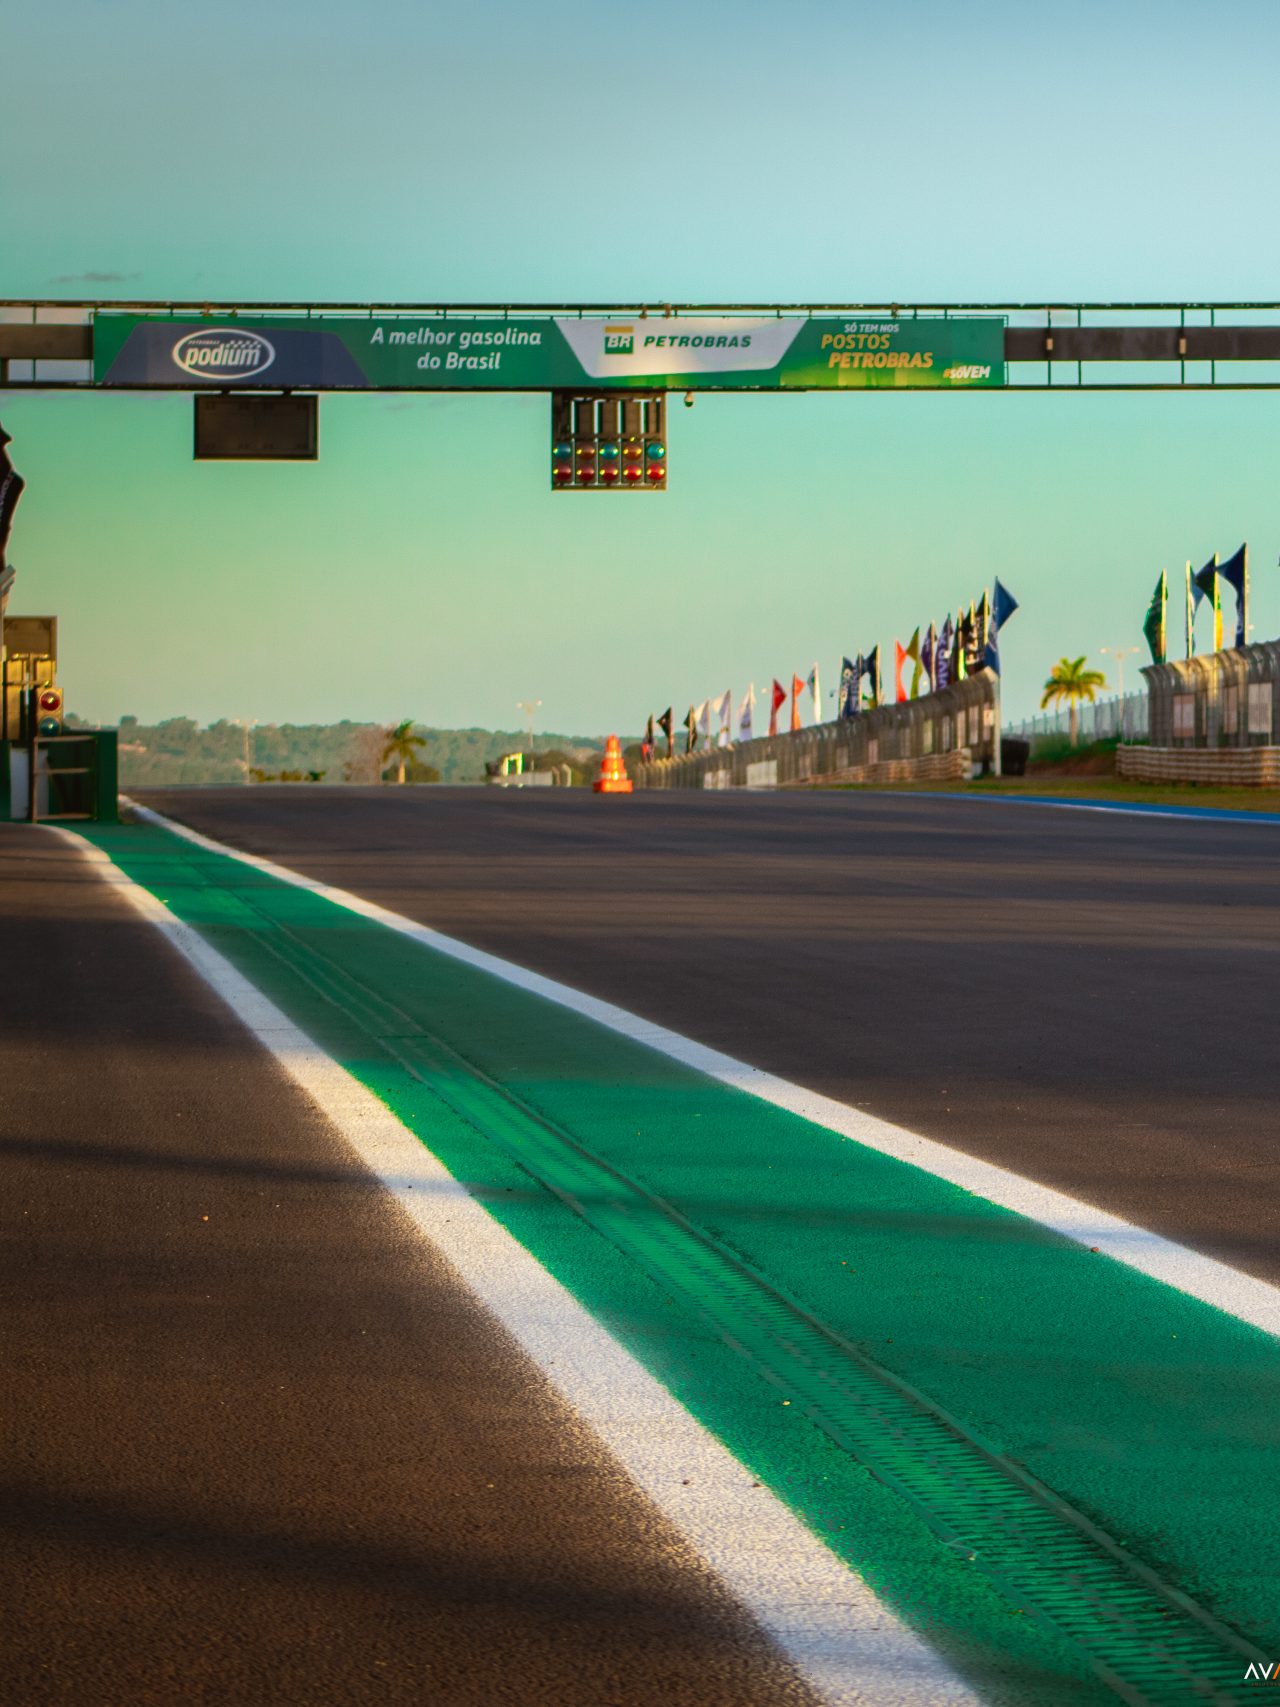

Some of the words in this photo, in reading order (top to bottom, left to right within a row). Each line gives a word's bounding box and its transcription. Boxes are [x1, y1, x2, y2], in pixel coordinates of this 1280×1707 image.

[844, 322, 858, 333] SÓ
[859, 324, 879, 333] TEM
[879, 324, 900, 333] NOS
[370, 327, 384, 345] A
[388, 328, 456, 345] melhor
[459, 328, 542, 350] gasolina
[609, 336, 631, 348] BR
[643, 335, 752, 348] PETROBRAS
[821, 334, 891, 349] POSTOS
[186, 344, 260, 369] podium
[417, 352, 441, 370] do
[446, 352, 501, 370] Brasil
[828, 352, 934, 368] PETROBRAS
